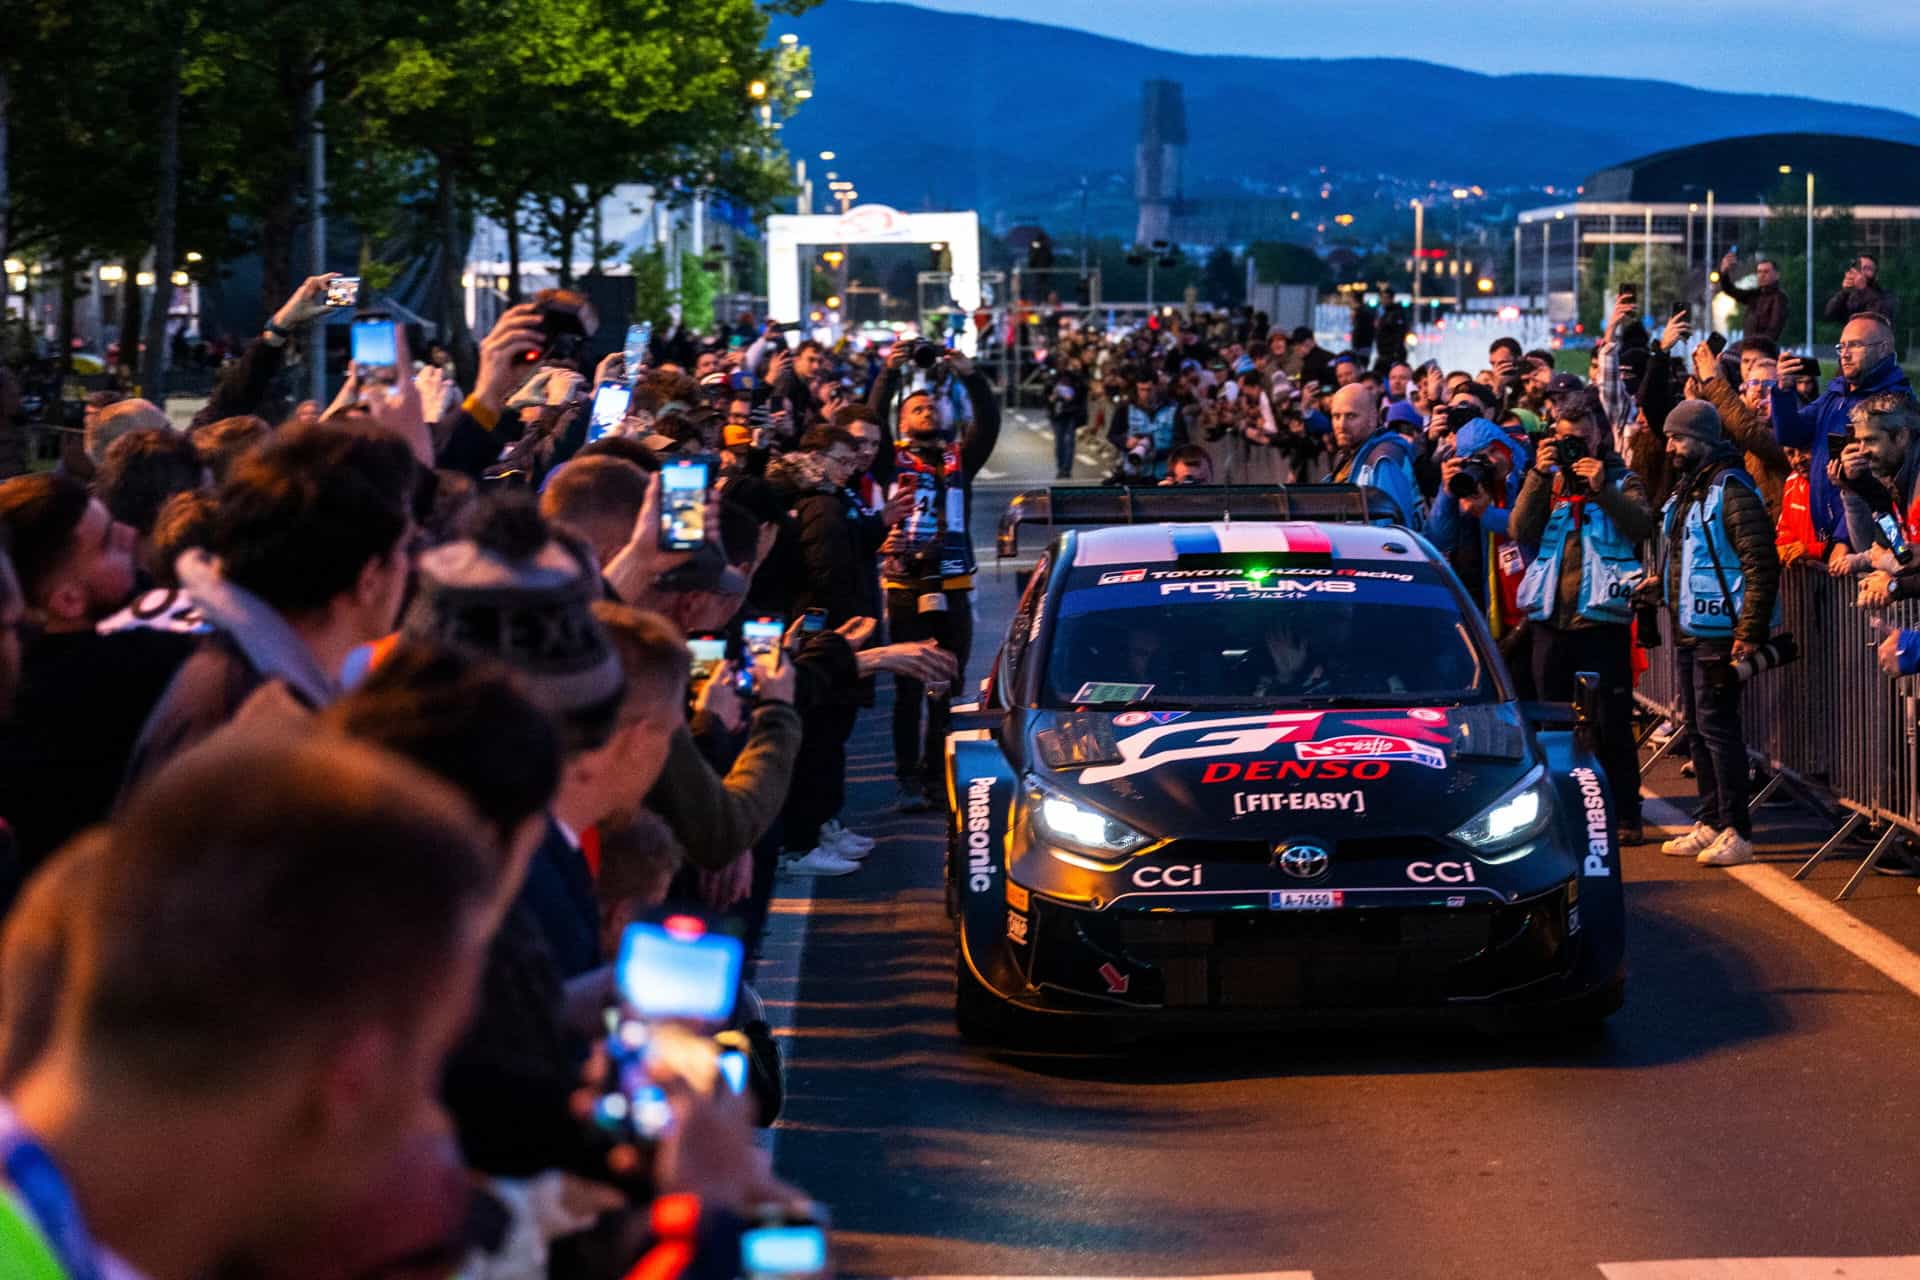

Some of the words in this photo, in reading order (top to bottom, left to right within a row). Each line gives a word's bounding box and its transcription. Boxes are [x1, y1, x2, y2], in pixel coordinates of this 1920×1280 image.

[1150, 568, 1243, 579] TOYOTA
[1336, 569, 1414, 582] Racing
[1161, 580, 1357, 595] FORUM8
[1201, 760, 1391, 784] DENSO
[1569, 767, 1611, 877] Panasonic
[968, 776, 997, 893] Panasonic
